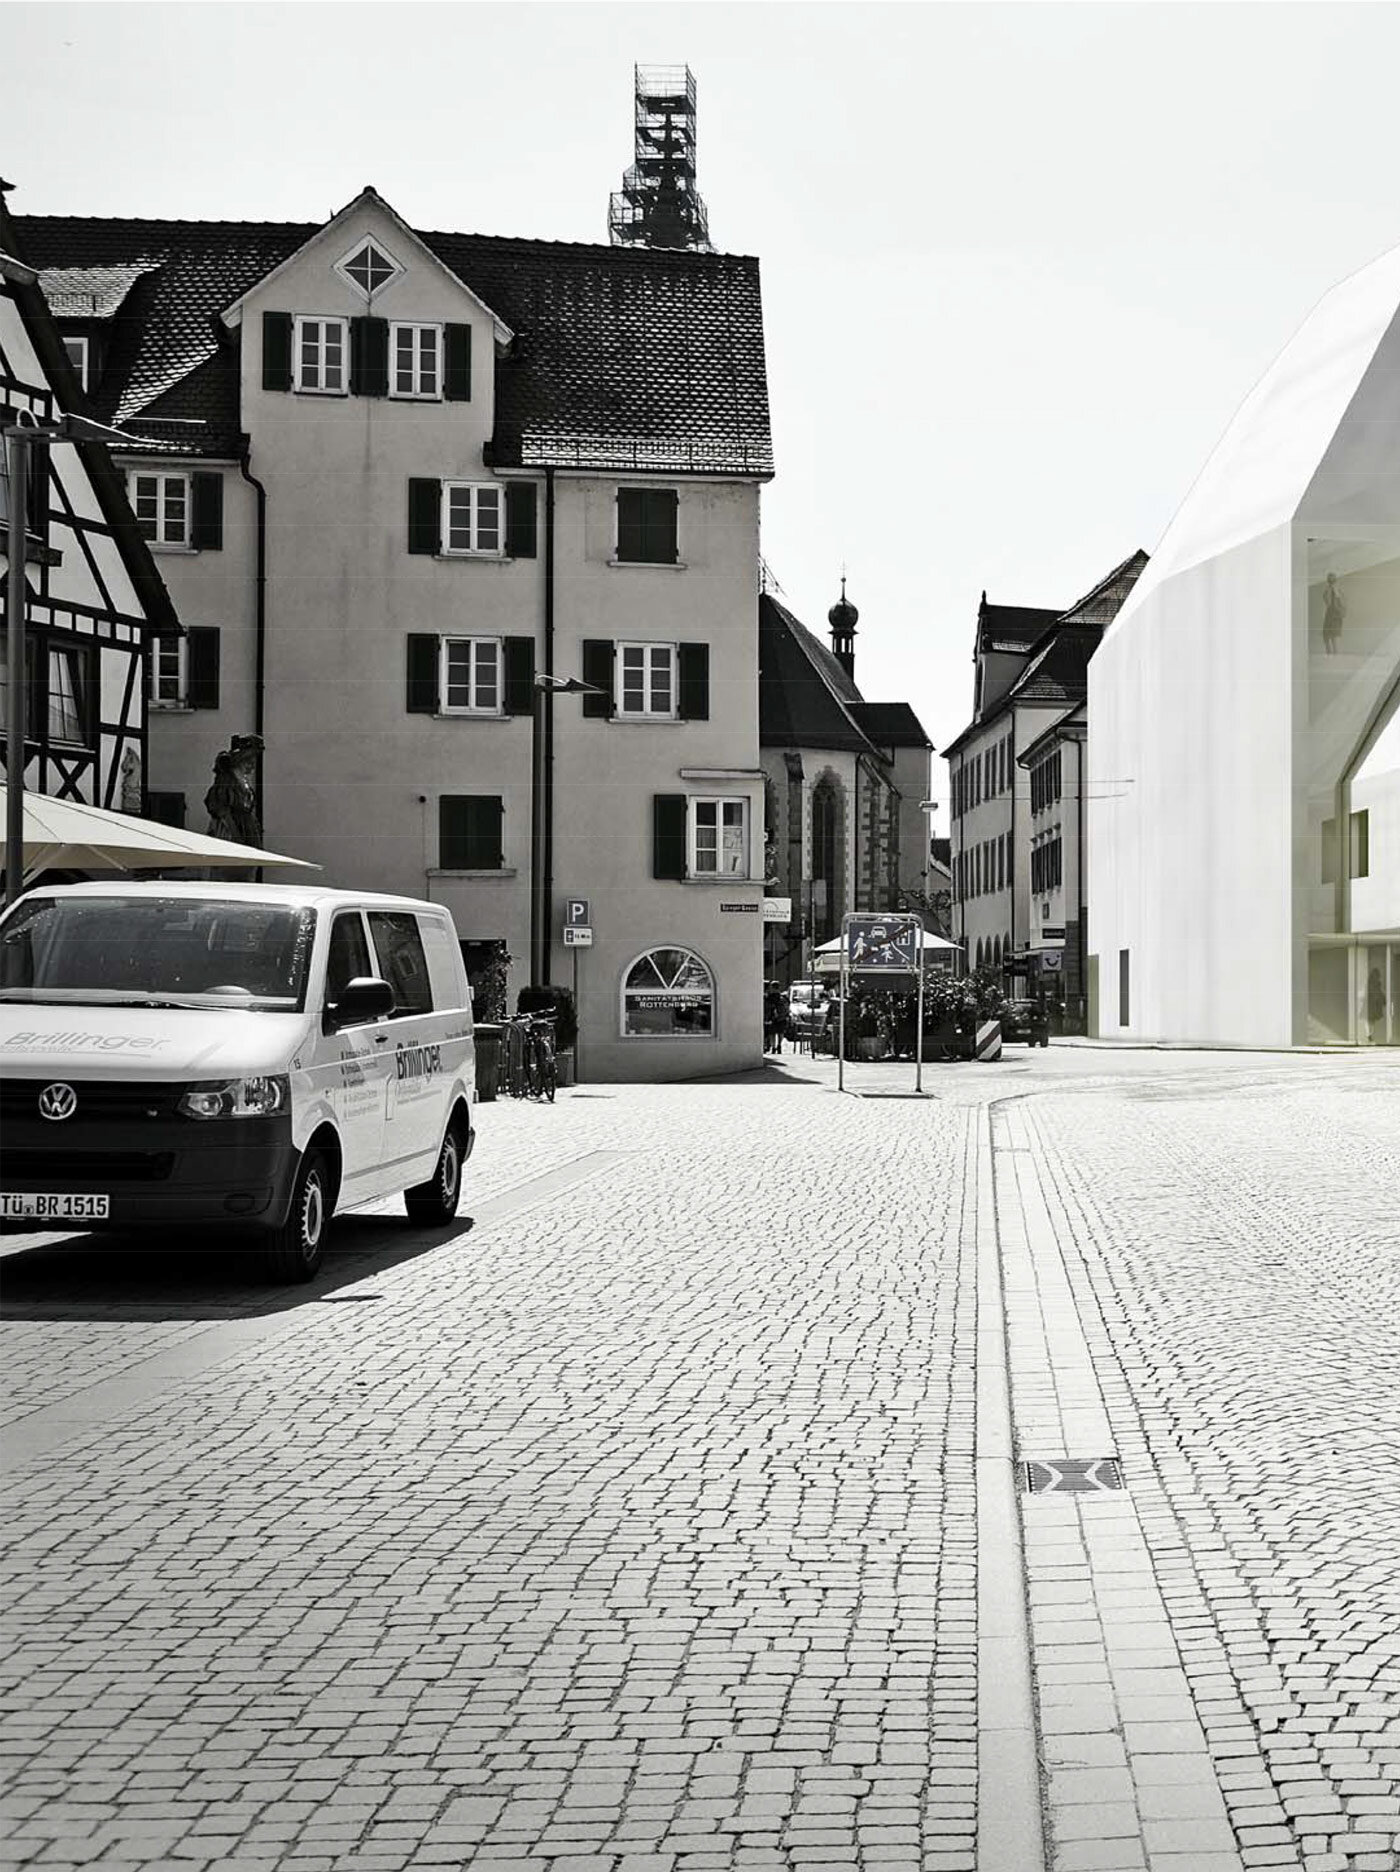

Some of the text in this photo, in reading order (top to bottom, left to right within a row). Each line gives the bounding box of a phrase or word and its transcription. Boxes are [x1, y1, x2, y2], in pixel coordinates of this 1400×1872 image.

[572, 903, 584, 922] P
[2, 1195, 107, 1216] TÜ BR 1515
